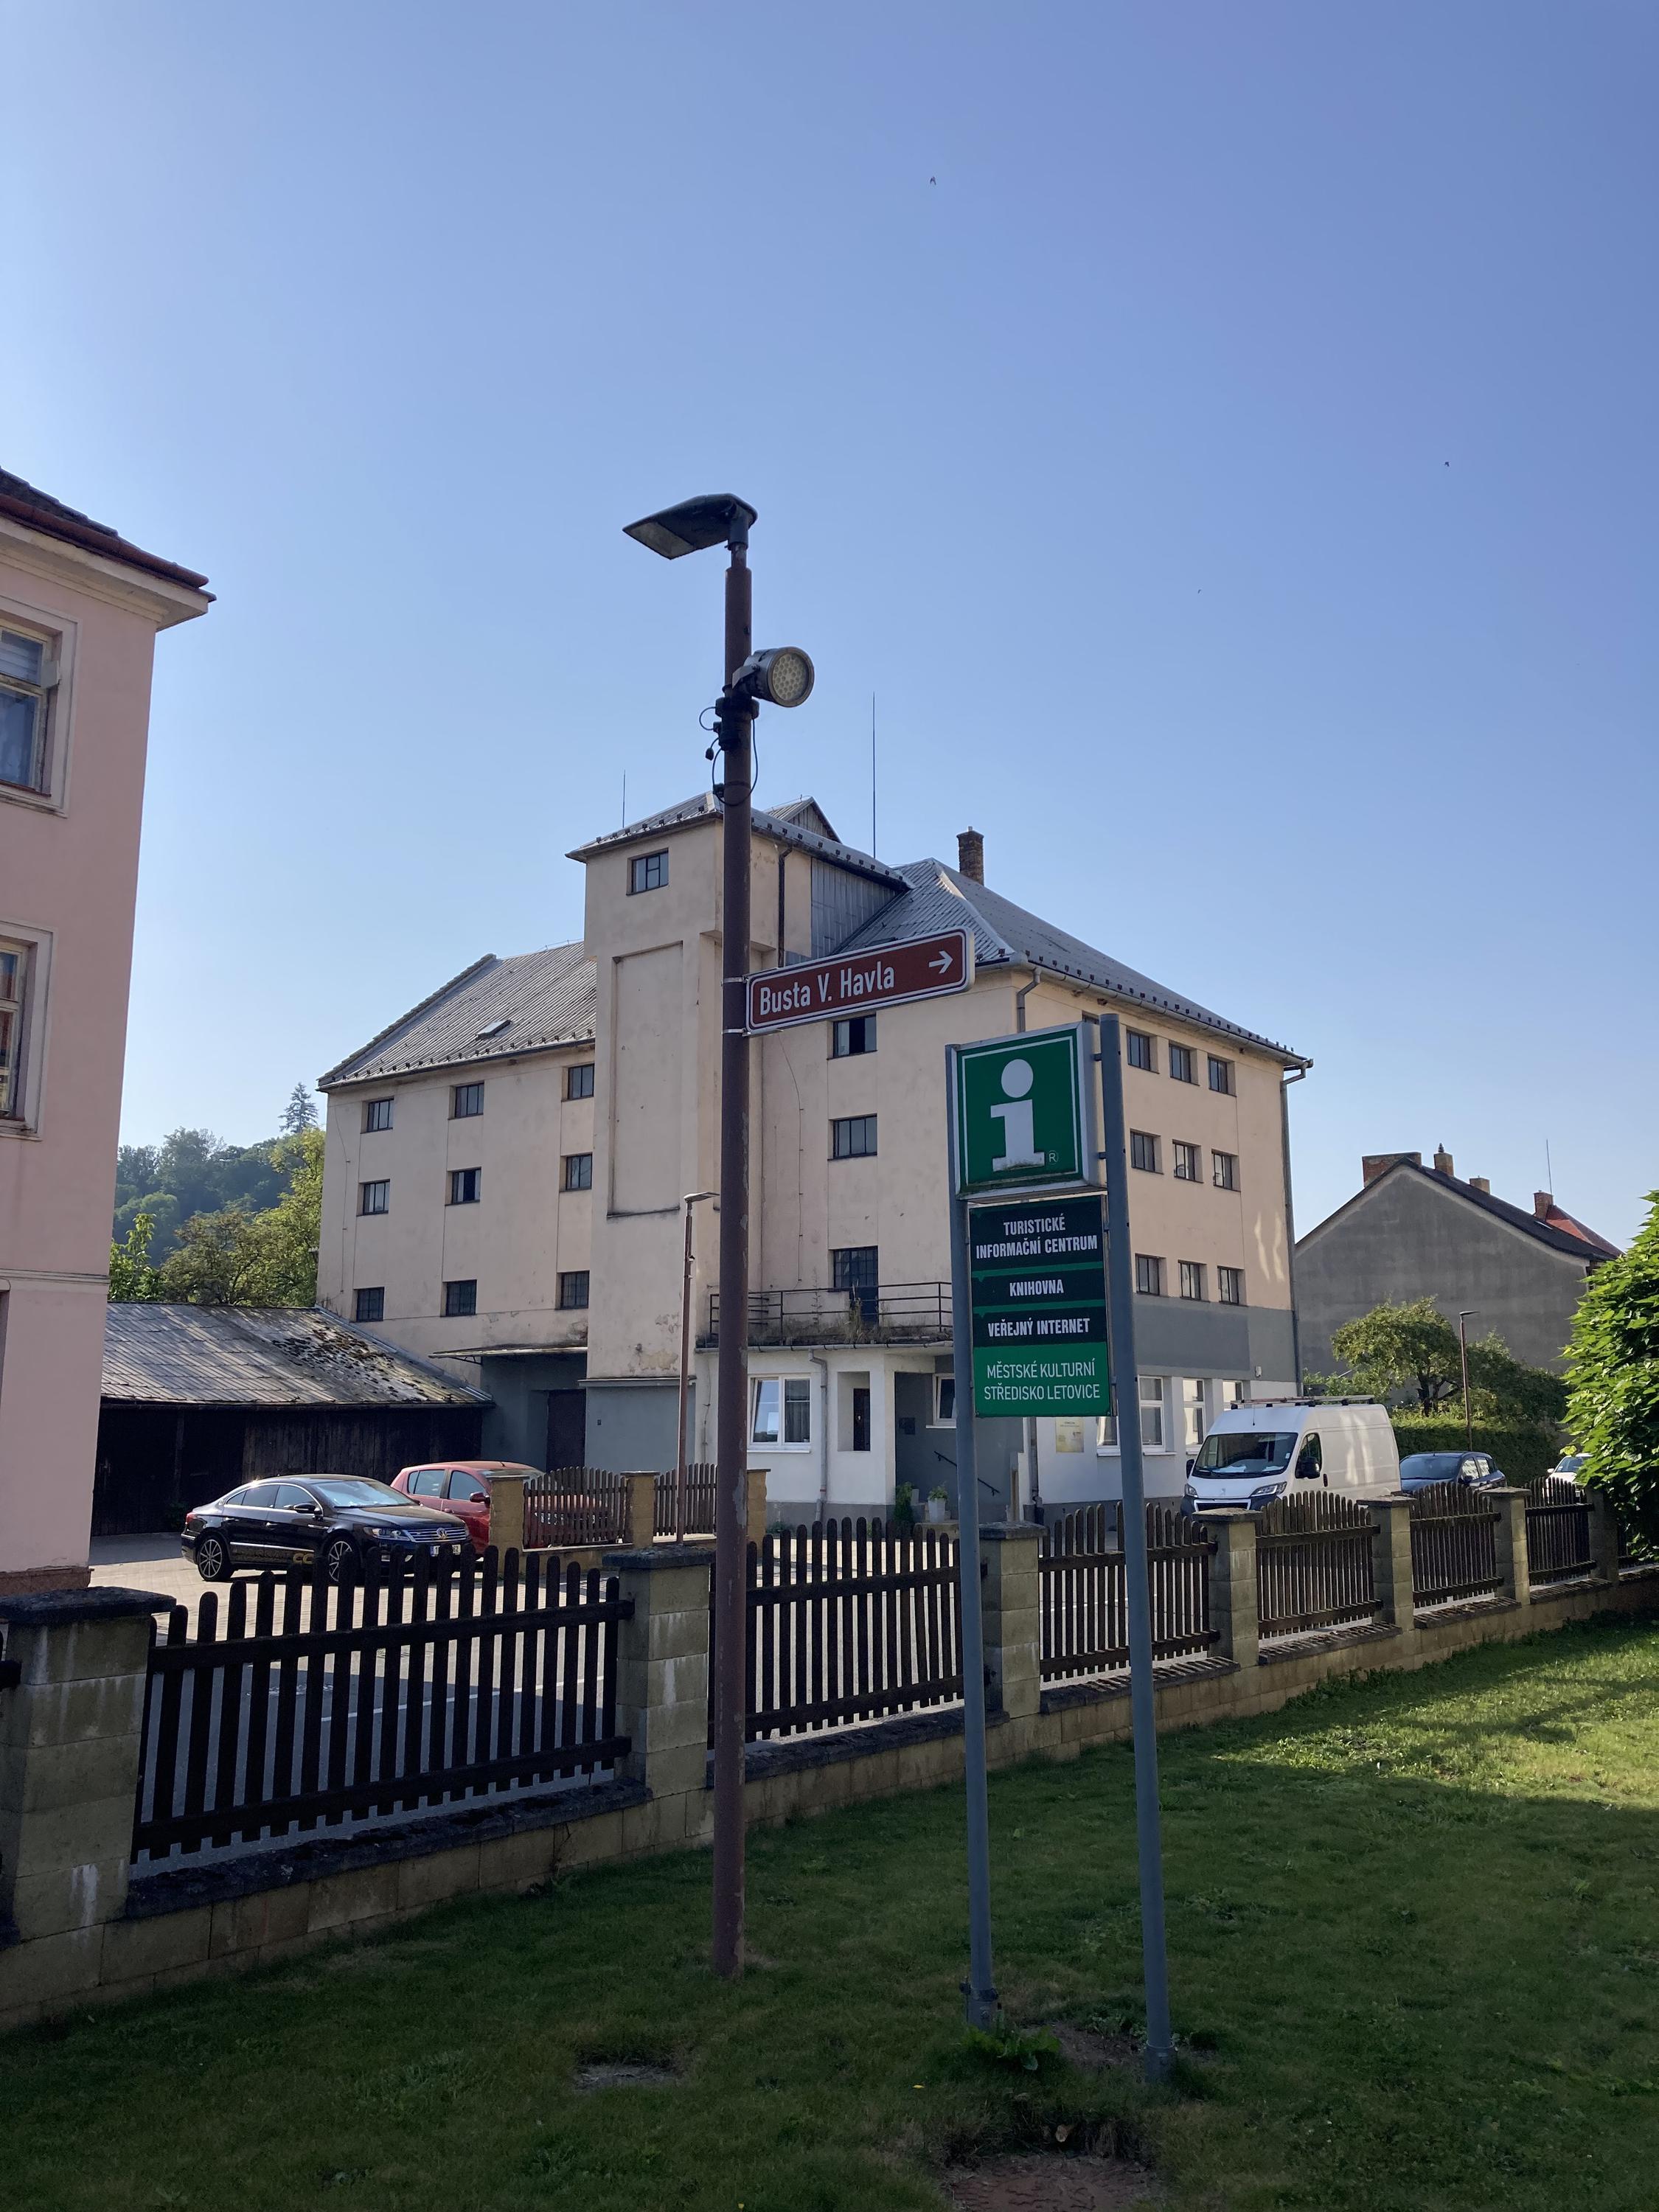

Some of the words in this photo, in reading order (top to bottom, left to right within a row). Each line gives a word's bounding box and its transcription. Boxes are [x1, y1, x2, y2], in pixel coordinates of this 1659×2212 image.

[759, 981, 811, 1015] Busta
[817, 973, 832, 1003] V.
[840, 961, 894, 998] Havla
[1003, 1213, 1066, 1236] TURISTICKÉ
[975, 1236, 1041, 1259] INFORMAČNÍ
[1044, 1235, 1098, 1253] CENTRUM
[1009, 1279, 1064, 1297] KNIHOVNA
[987, 1318, 1033, 1337] VEŘEJNÝ
[1037, 1318, 1091, 1335] INTERNET
[987, 1360, 1038, 1379] MĚSTSKÉ
[1040, 1357, 1095, 1377] KULTURNÍ
[984, 1382, 1045, 1400] STŘEDISKO
[1047, 1384, 1101, 1399] LETOVICE
